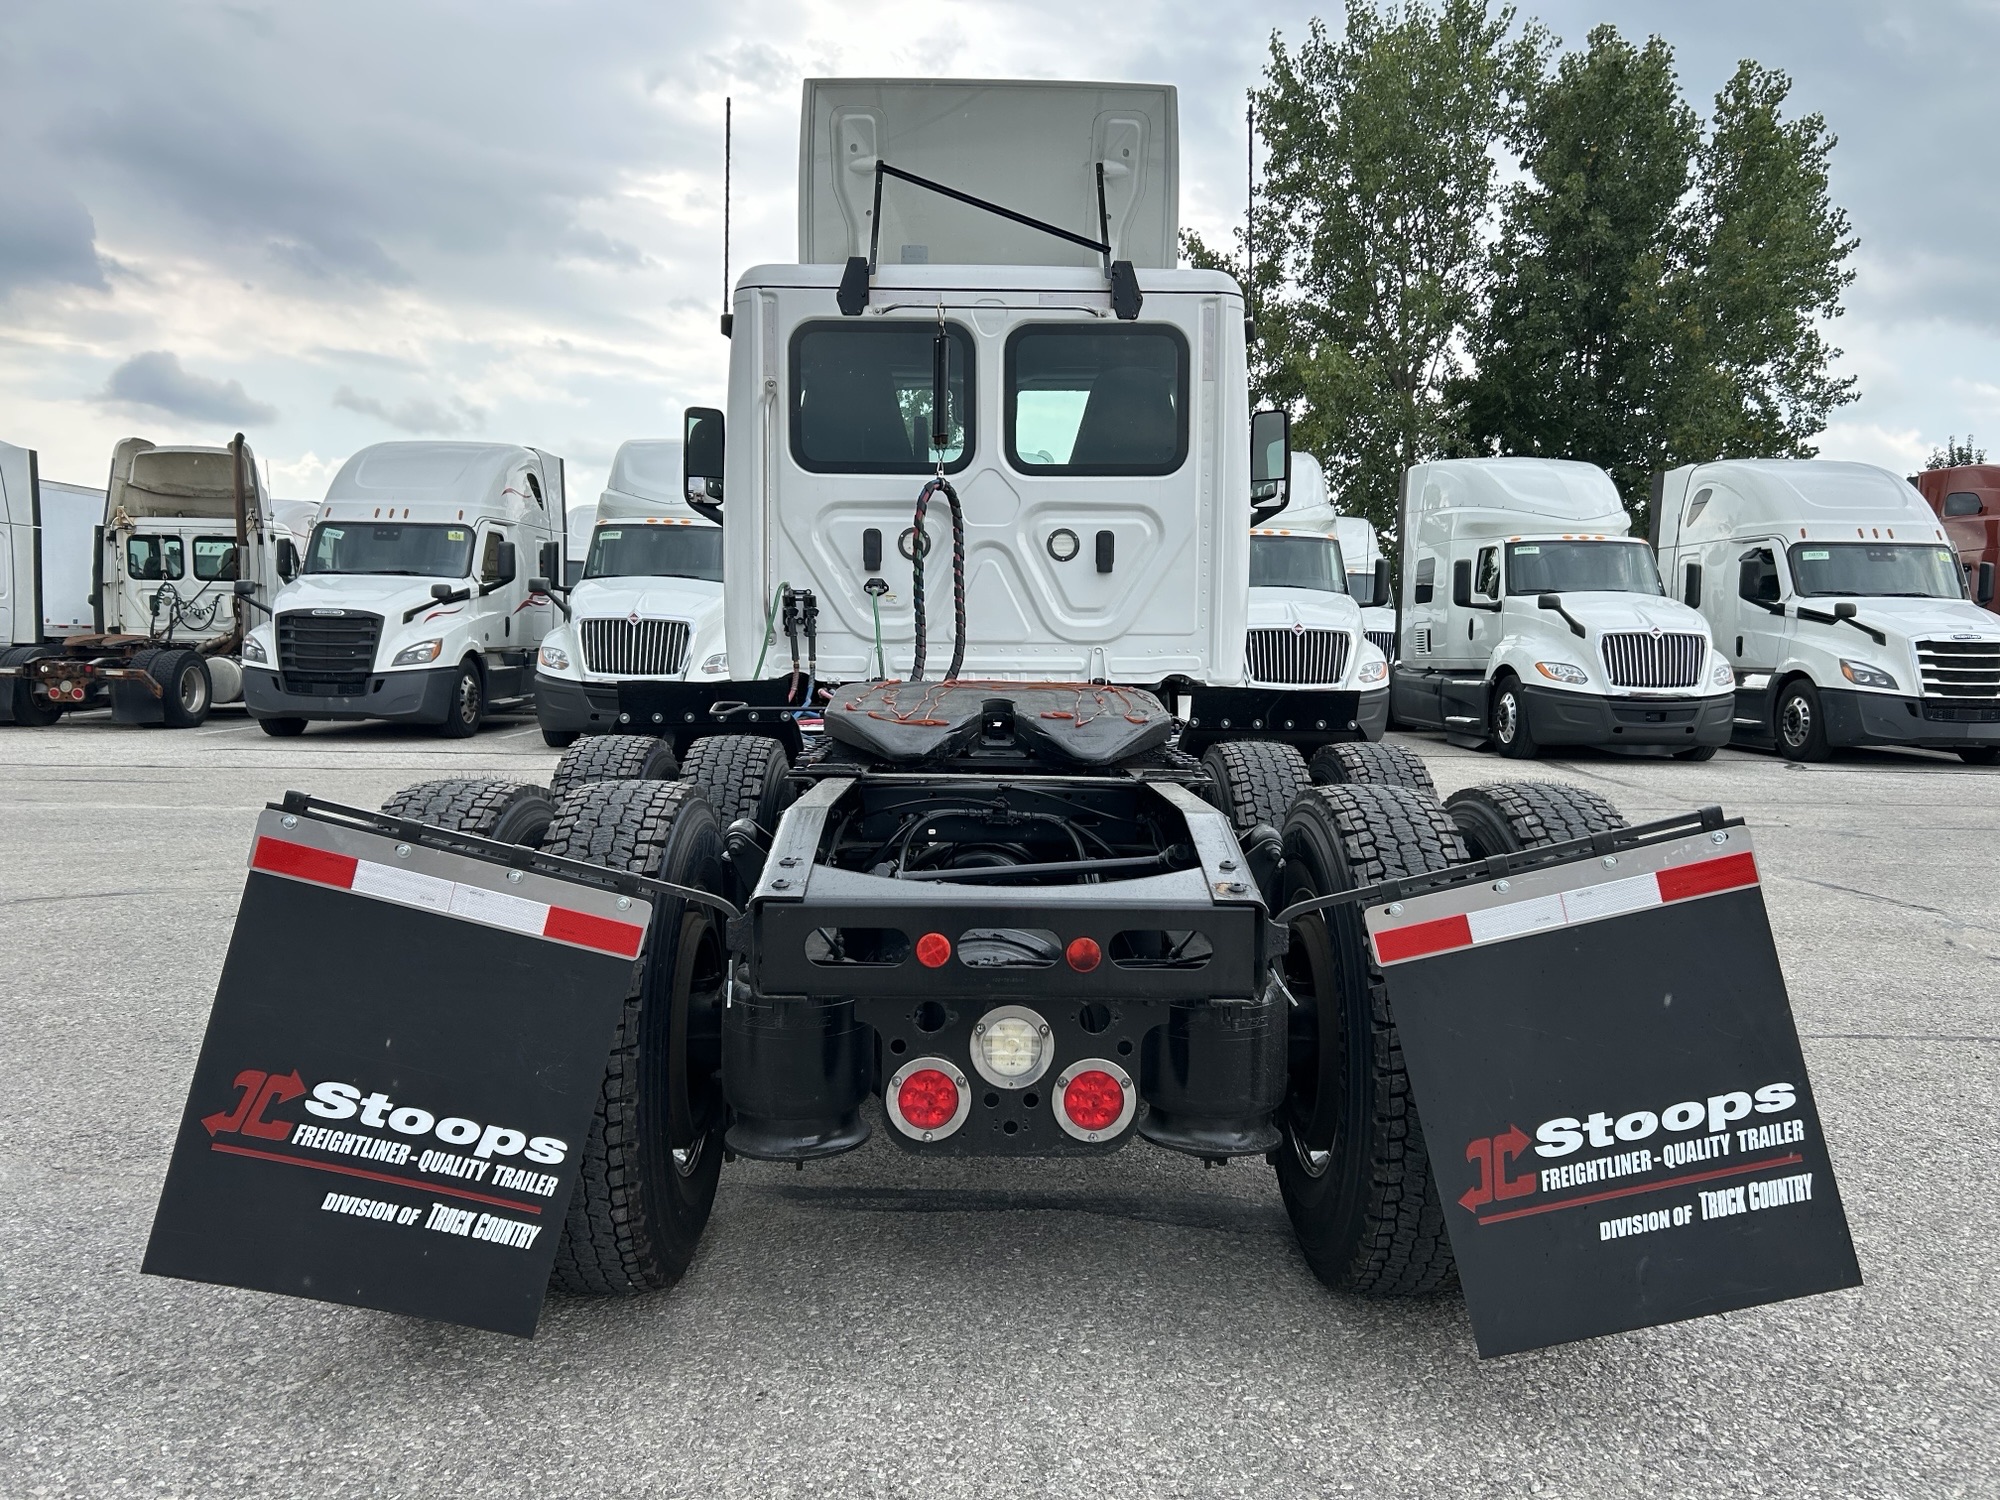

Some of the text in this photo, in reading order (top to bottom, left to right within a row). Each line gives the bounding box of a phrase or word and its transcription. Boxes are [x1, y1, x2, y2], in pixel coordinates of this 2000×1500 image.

[305, 1082, 568, 1165] Stoops
[1534, 1082, 1797, 1158] Stoops
[1736, 1119, 1805, 1153] TRAILER
[491, 1164, 559, 1197] TRAILER
[1599, 1172, 1813, 1241] DIVISION OF TRUCK COUNTRY
[320, 1192, 542, 1250] DIVISION OF TRUCK COUNTRY
